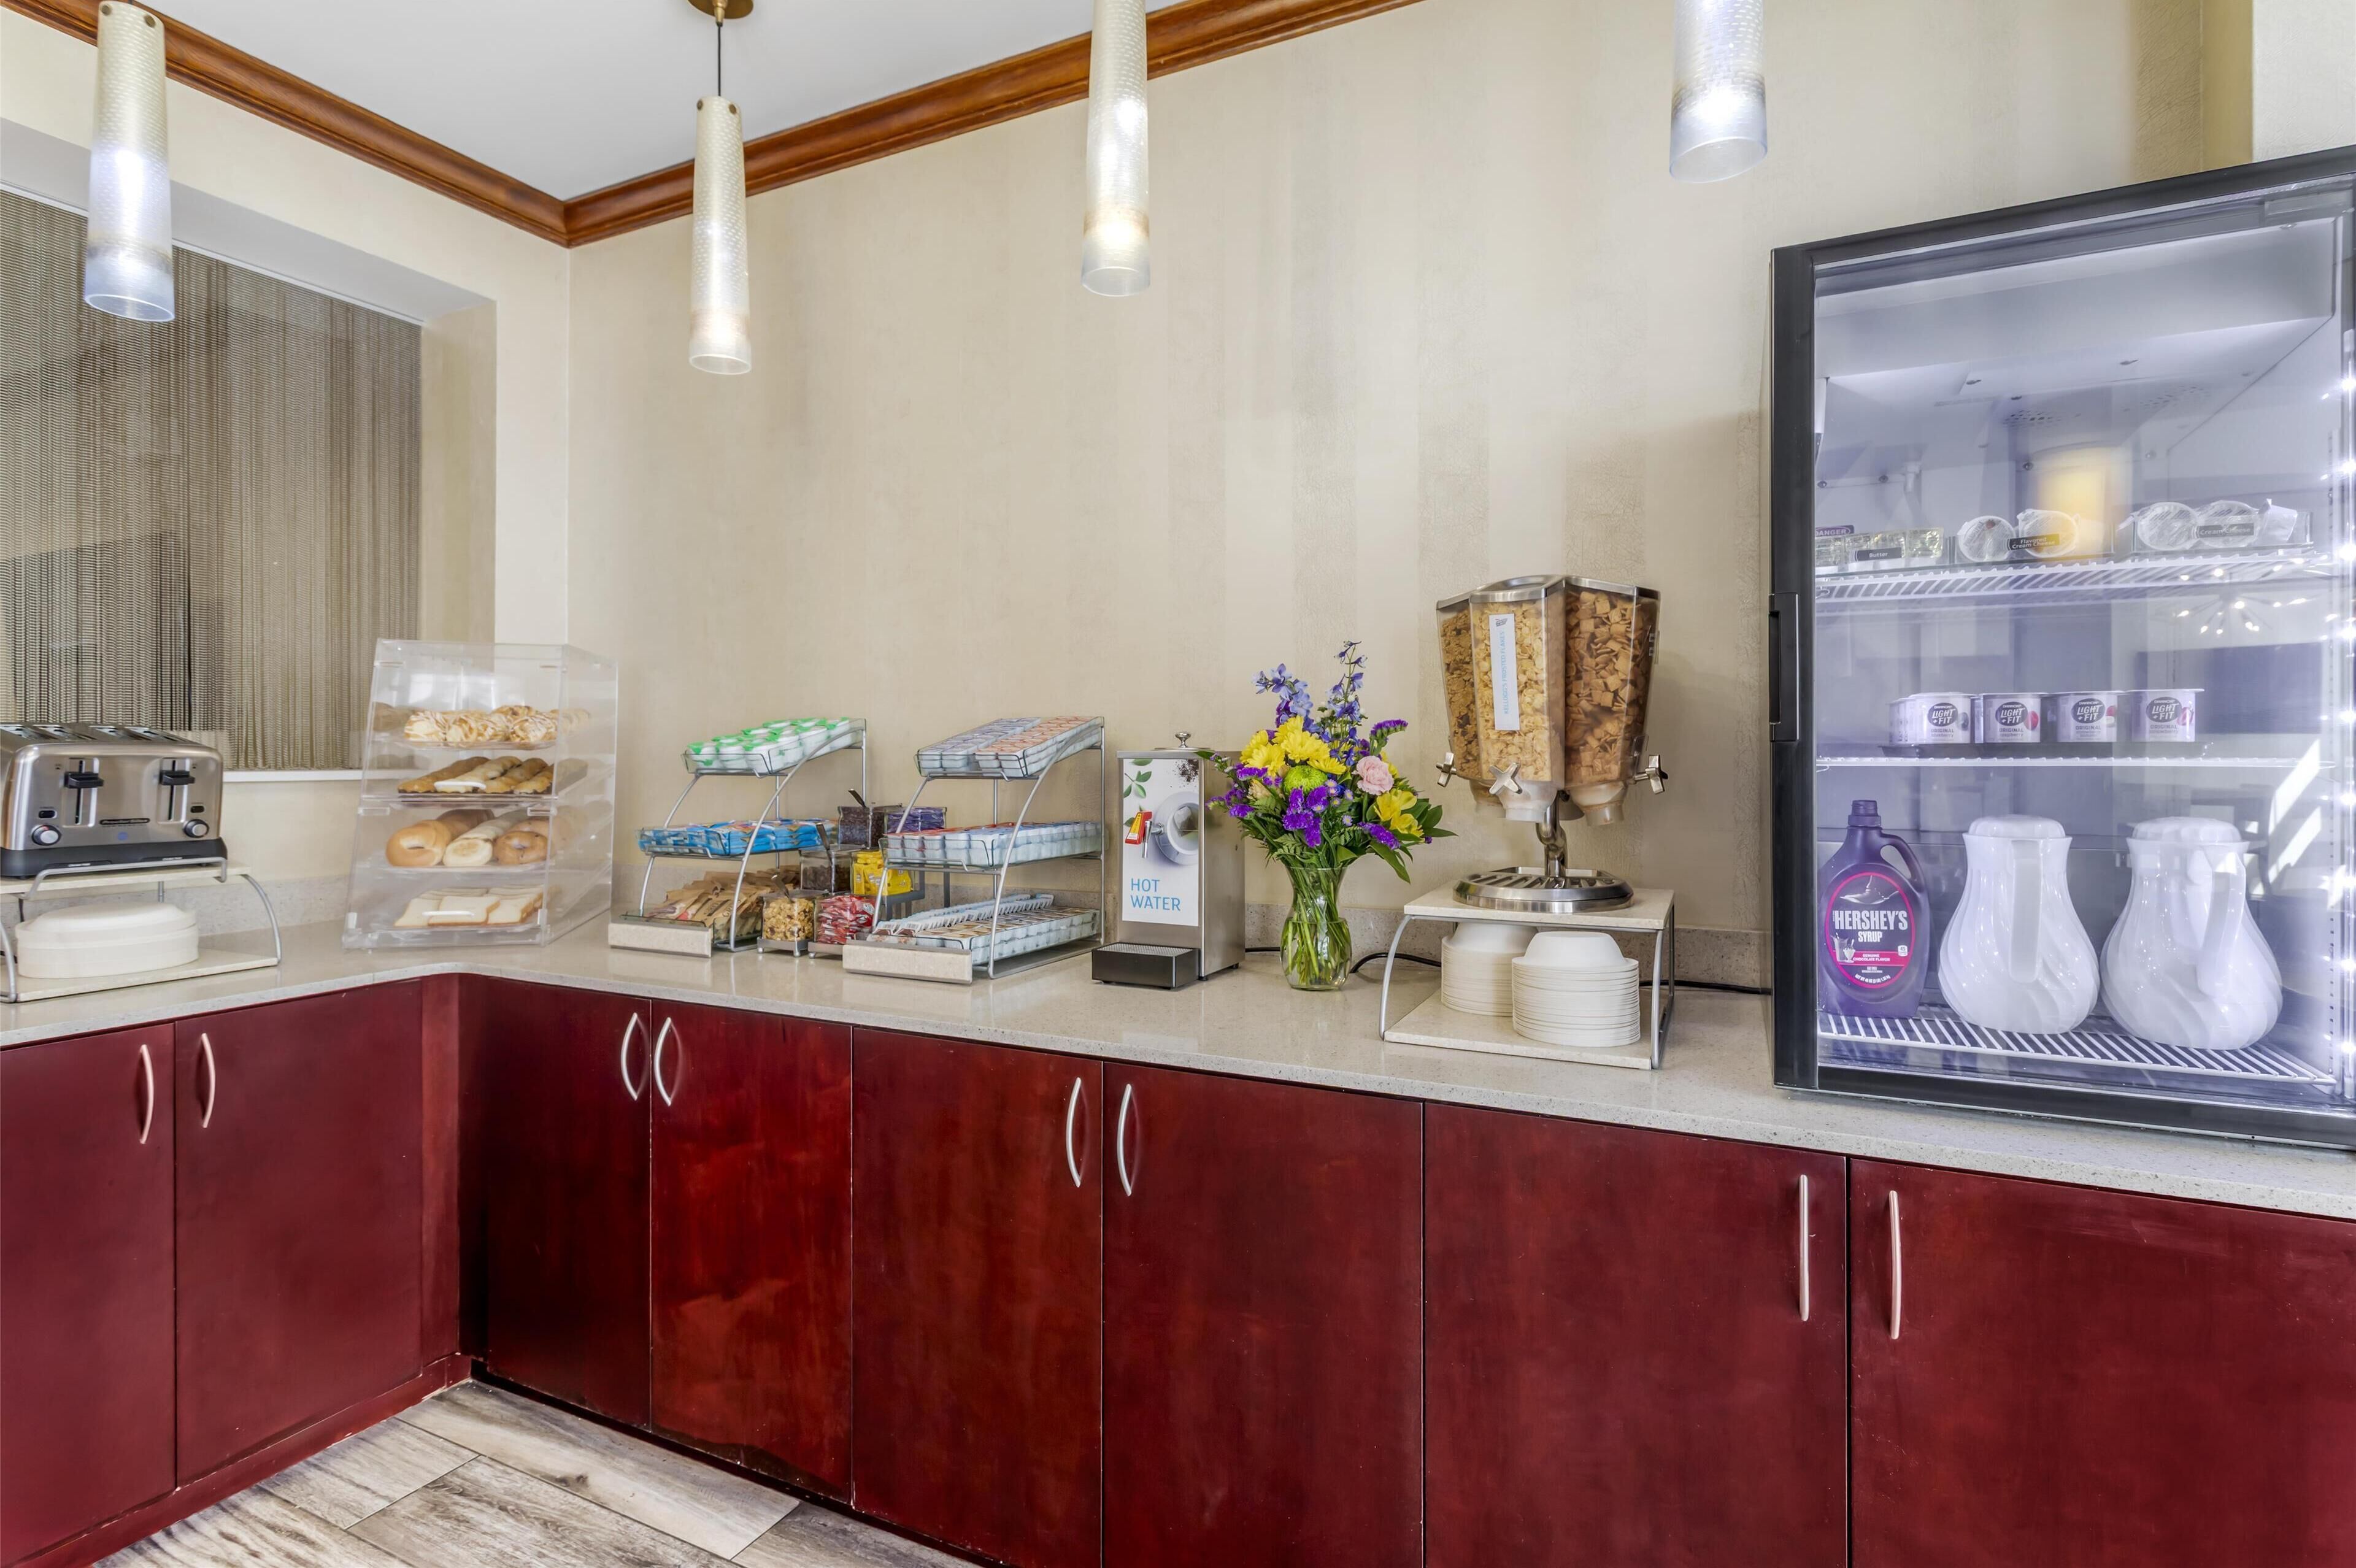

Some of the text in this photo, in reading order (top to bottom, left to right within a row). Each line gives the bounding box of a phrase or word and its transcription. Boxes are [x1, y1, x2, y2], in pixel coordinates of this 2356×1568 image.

[1932, 709, 1956, 718] LIGHT
[2000, 707, 2025, 718] LIGHT
[2077, 705, 2103, 715] LIGHT
[2152, 703, 2180, 714] LIGHT
[1131, 878, 1160, 893] HOT
[1130, 894, 1181, 912] WATER
[1834, 910, 1908, 930] HERSHEY'S
[1858, 931, 1882, 942] SYRUP
